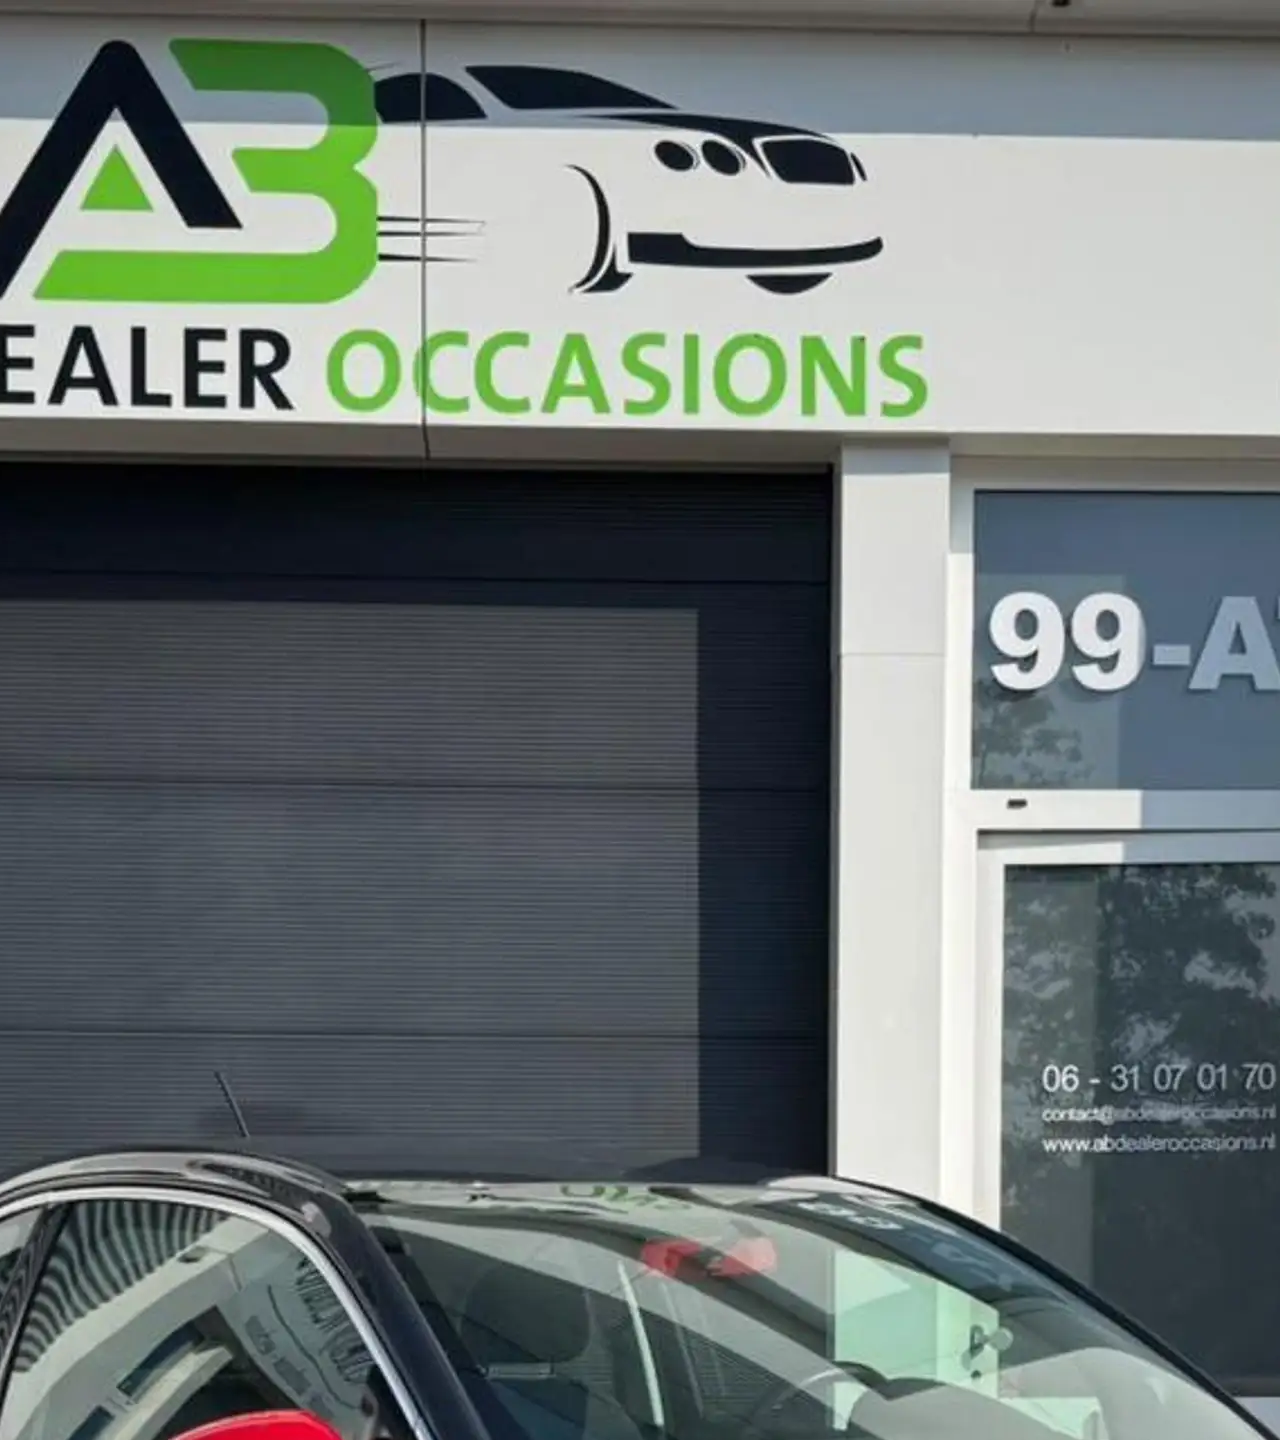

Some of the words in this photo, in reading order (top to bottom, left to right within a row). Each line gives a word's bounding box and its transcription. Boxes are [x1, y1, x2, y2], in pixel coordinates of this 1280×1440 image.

[326, 328, 930, 419] OCCASIONS
[1042, 1063, 1080, 1093] 06
[1111, 1063, 1140, 1093] 31
[1153, 1063, 1188, 1092] 07
[1197, 1063, 1228, 1092] 01
[1241, 1062, 1277, 1091] 70
[1041, 1132, 1277, 1153] www.abdealeroccasions.nl
